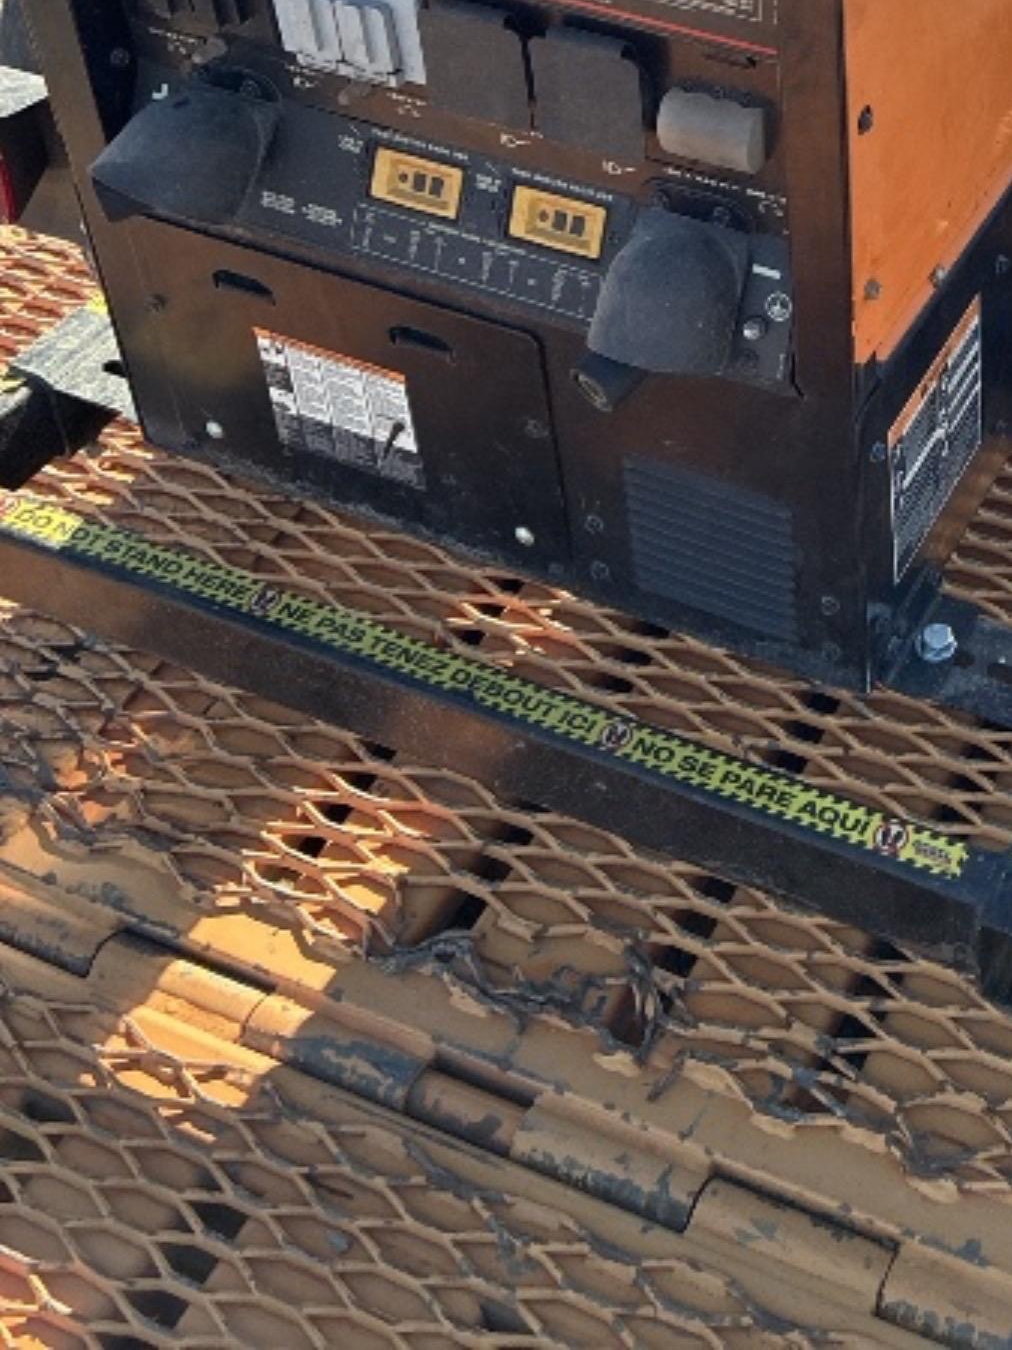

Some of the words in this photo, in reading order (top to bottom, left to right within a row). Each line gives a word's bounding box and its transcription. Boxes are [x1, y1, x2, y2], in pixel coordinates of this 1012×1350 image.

[15, 509, 52, 528] DO
[105, 538, 184, 574] STAND
[183, 567, 251, 598] HERE
[278, 602, 315, 622] NE
[316, 616, 366, 643] PAS
[371, 636, 449, 671] TENEZ
[452, 668, 557, 717] DEBOUT
[558, 711, 597, 732] ICI
[632, 737, 676, 762] NO
[678, 755, 716, 779] SE
[720, 770, 796, 807] PARE
